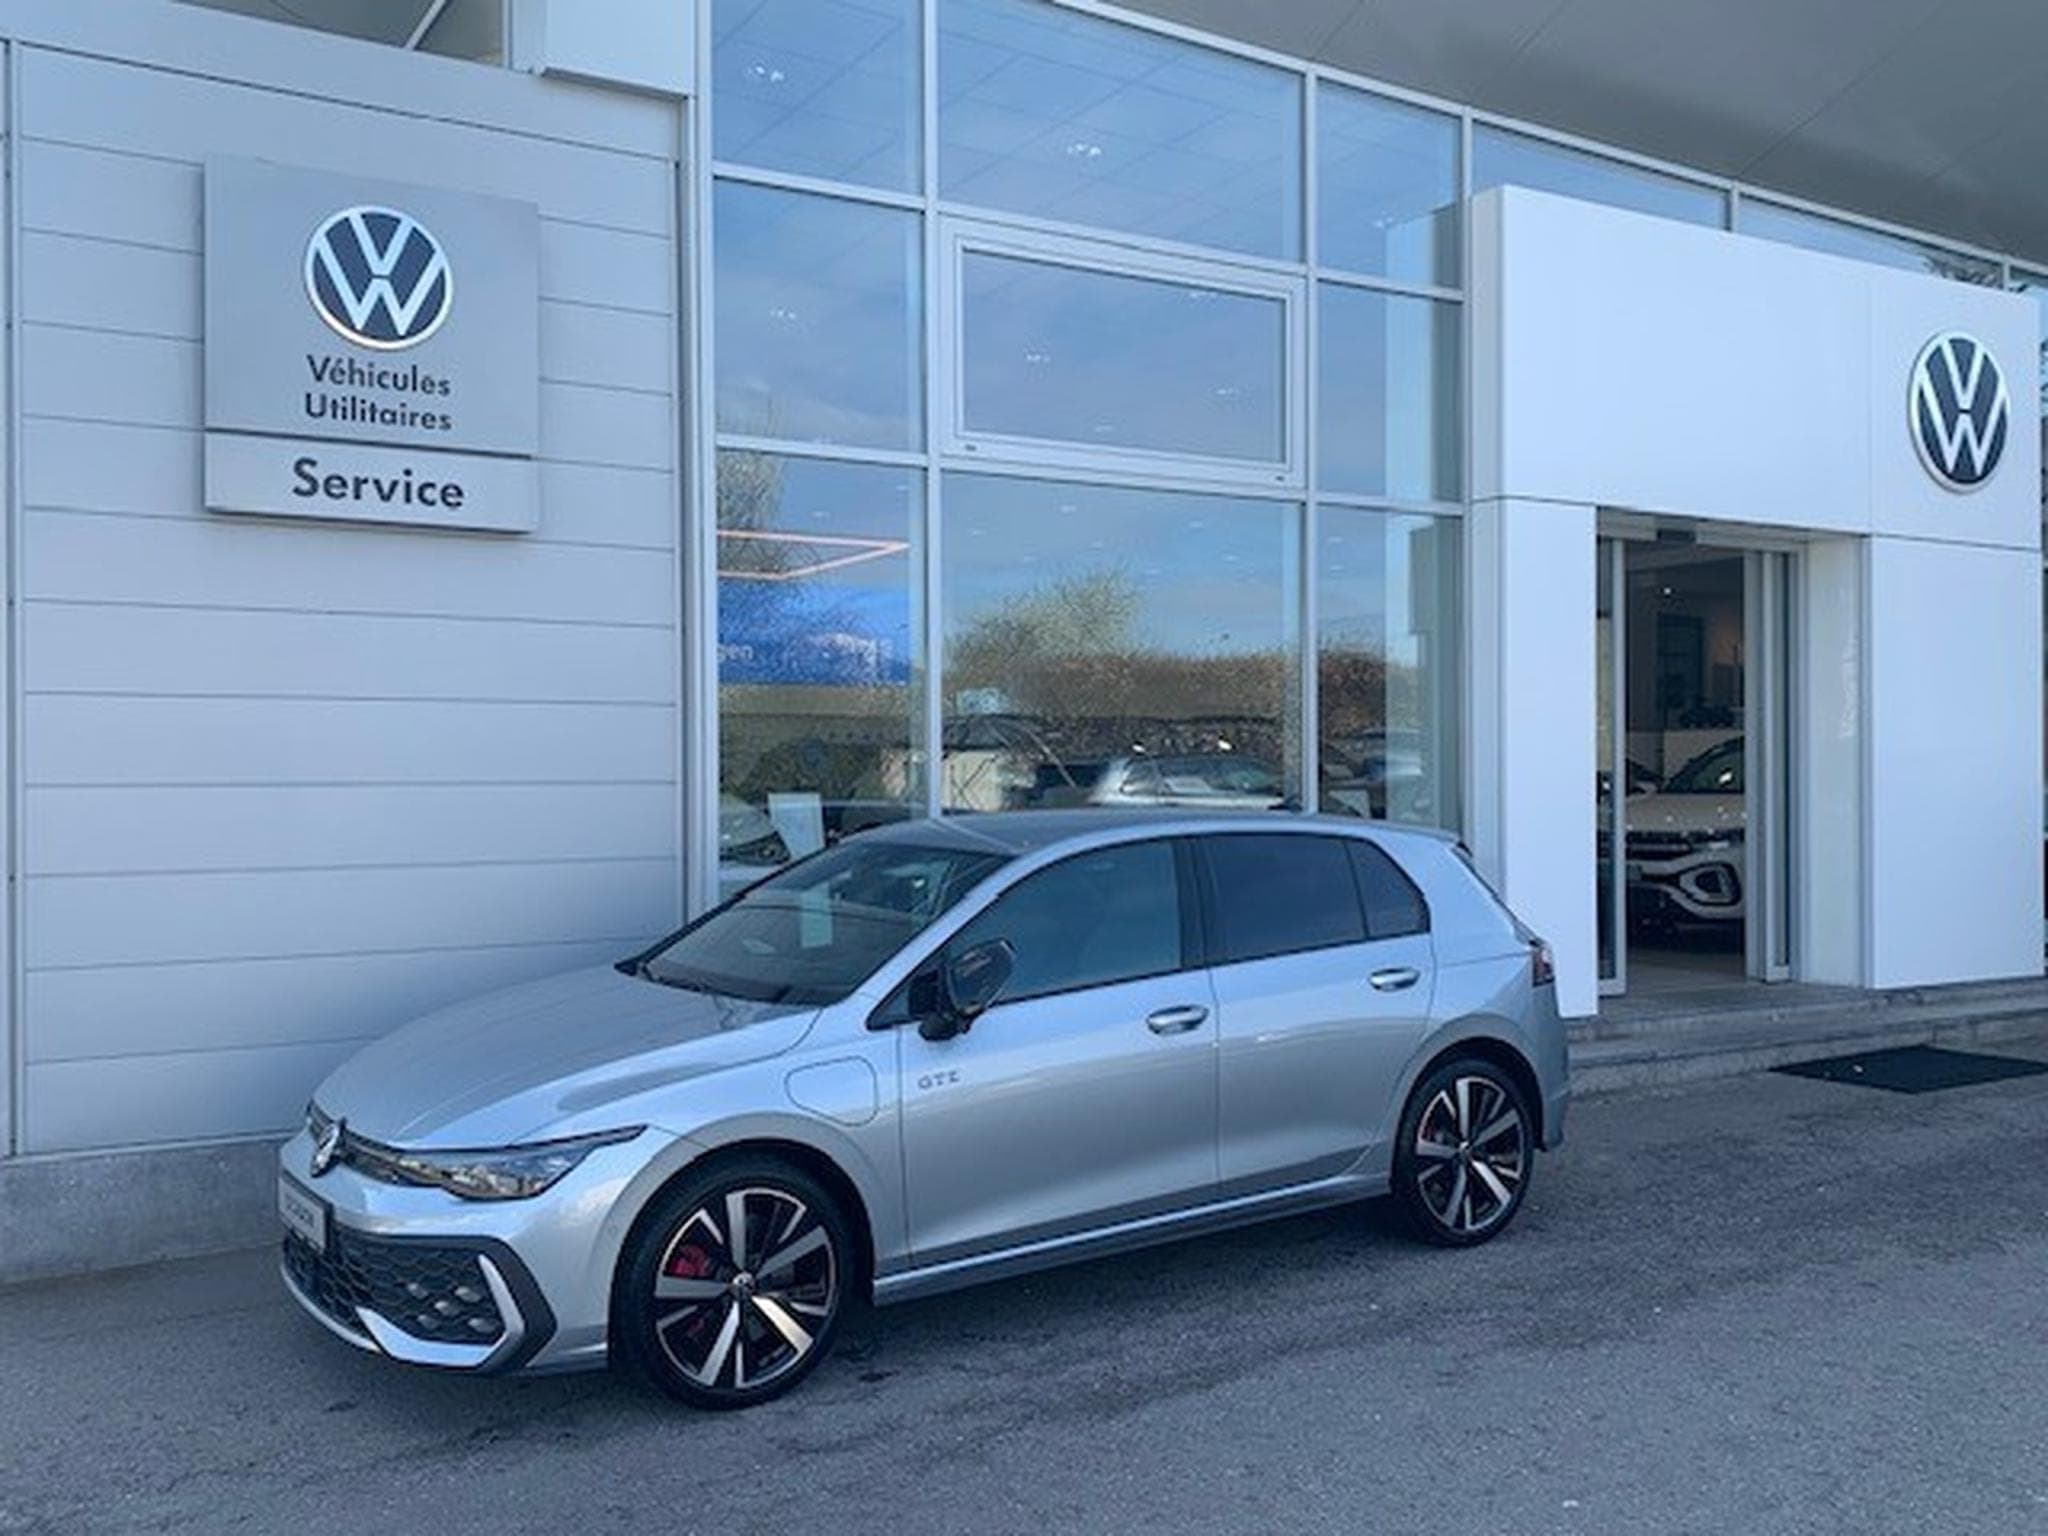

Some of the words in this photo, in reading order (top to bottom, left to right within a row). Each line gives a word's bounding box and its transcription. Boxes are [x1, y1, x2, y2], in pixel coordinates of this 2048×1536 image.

[306, 353, 450, 396] Véhicules
[306, 393, 451, 430] Utilitaires
[292, 456, 464, 508] Service
